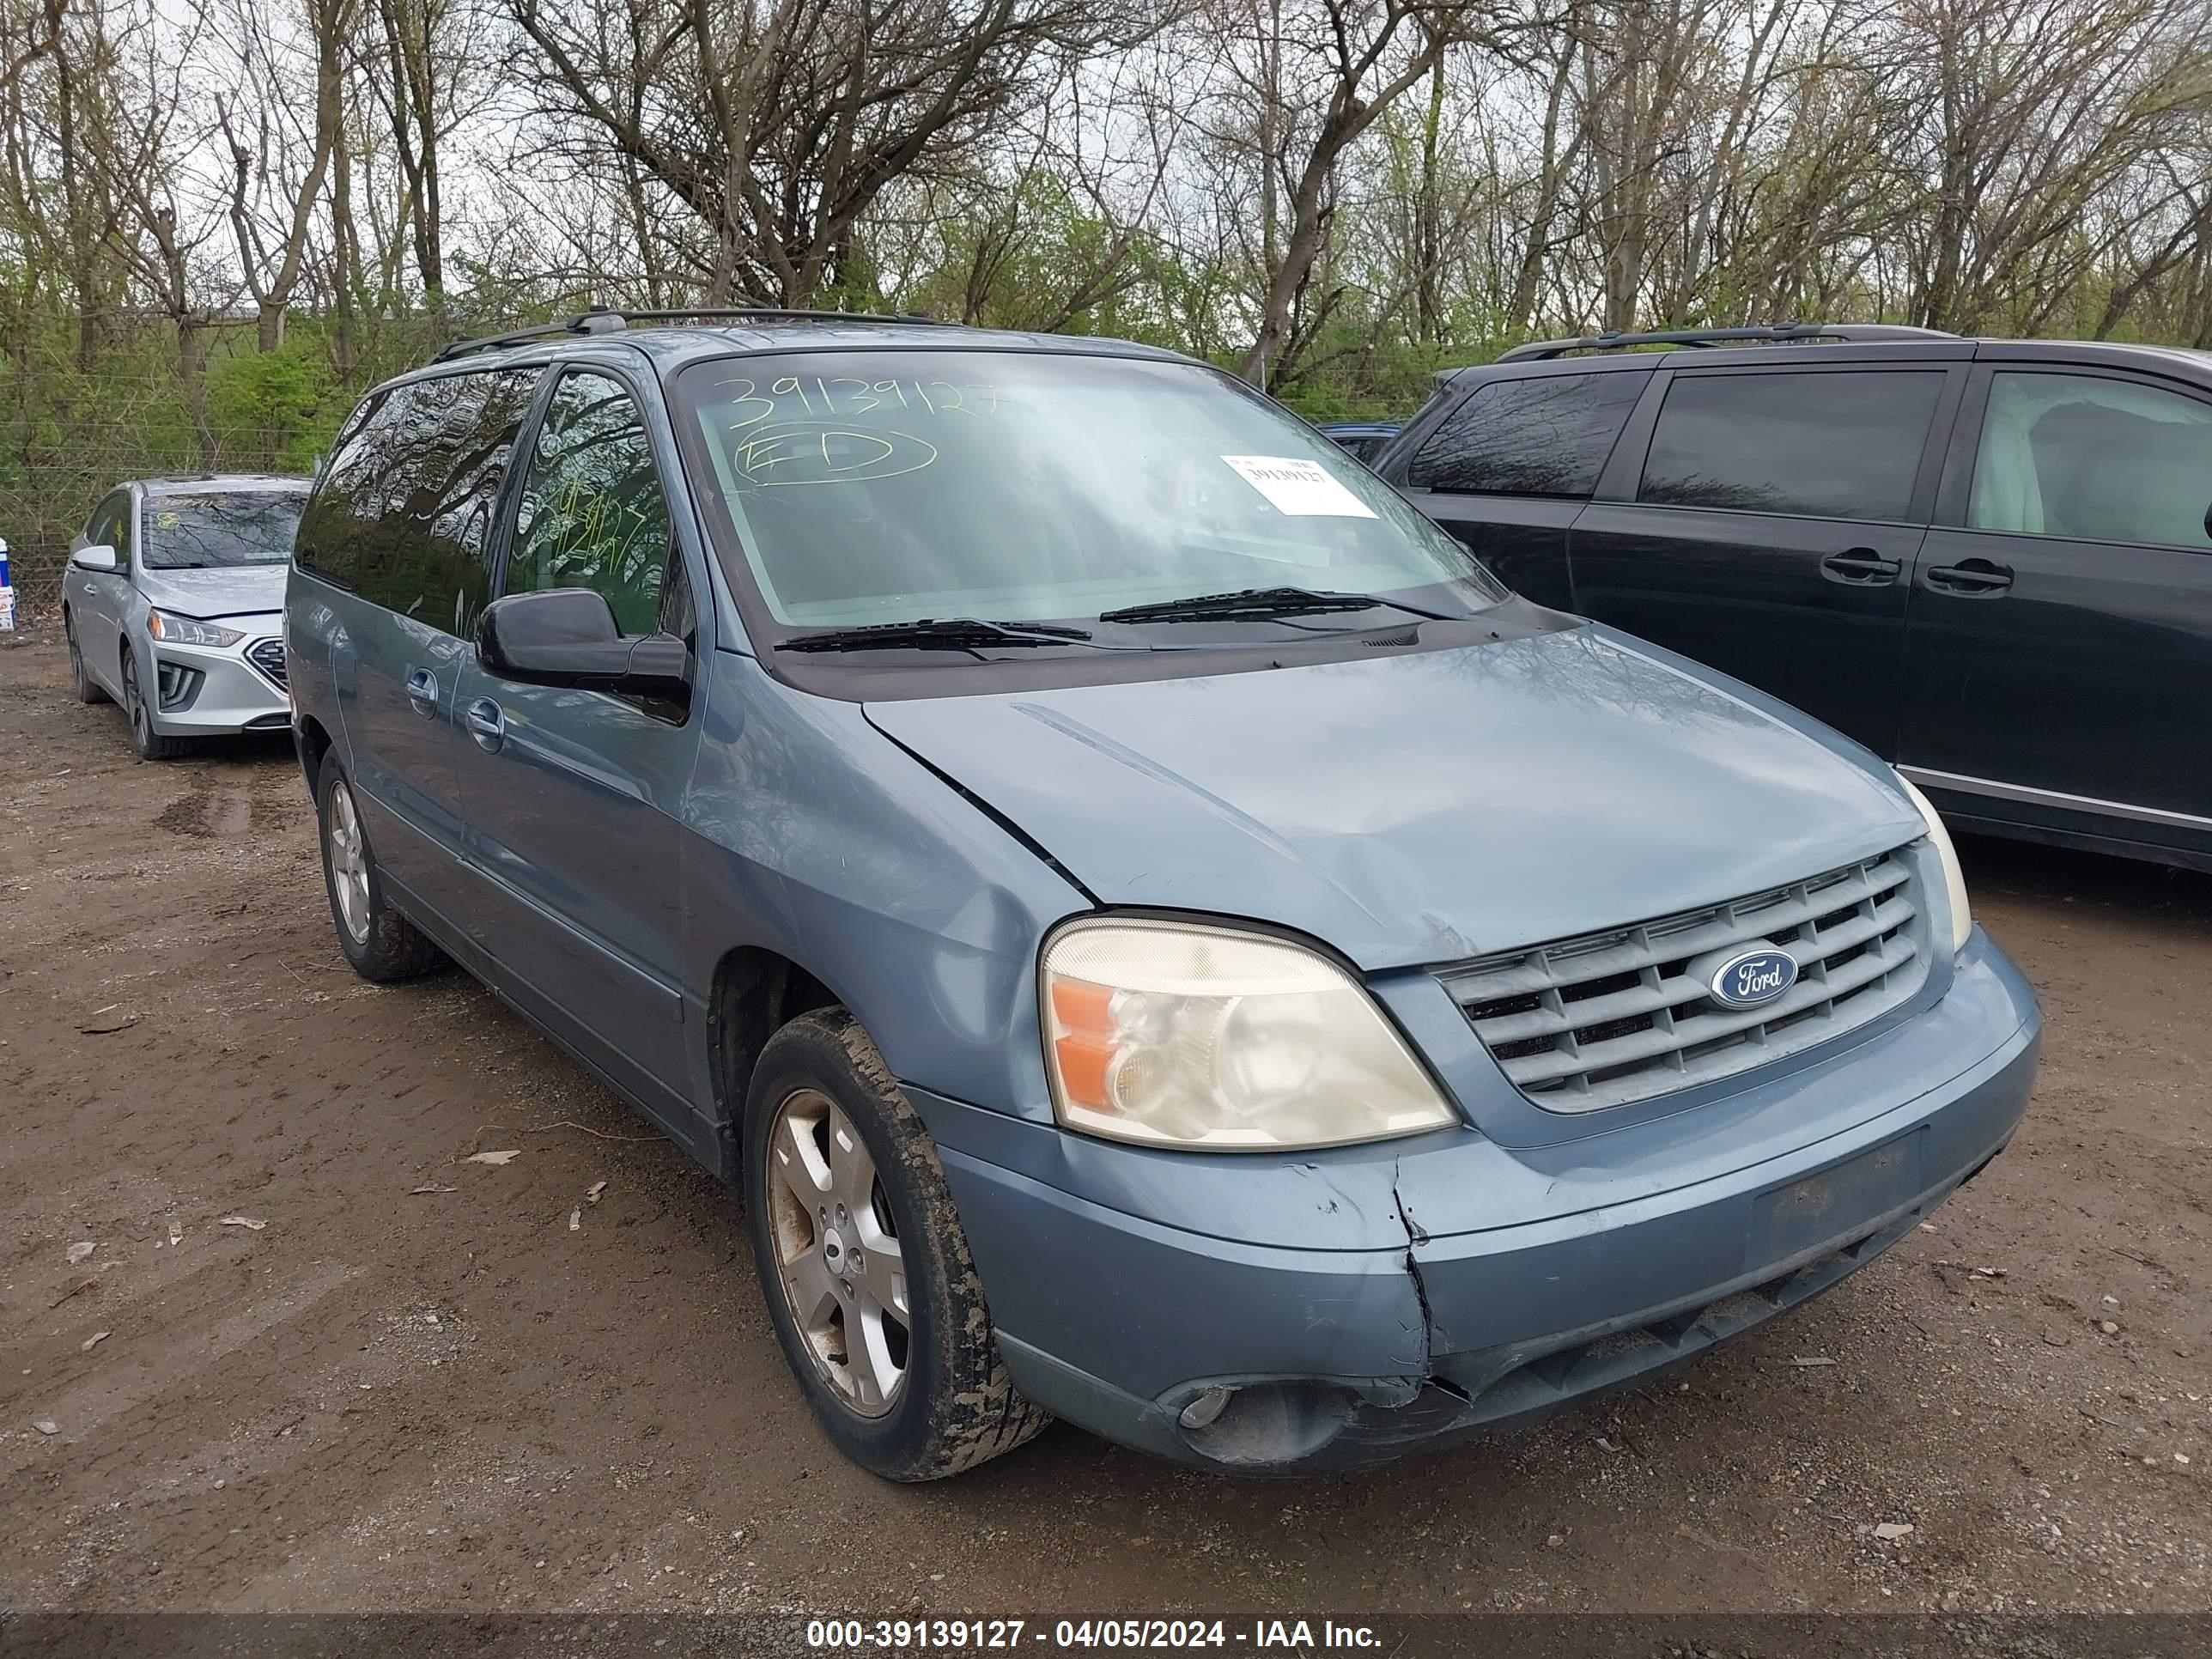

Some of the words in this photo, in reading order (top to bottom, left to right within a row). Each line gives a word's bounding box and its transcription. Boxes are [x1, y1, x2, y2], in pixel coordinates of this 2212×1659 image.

[714, 377, 1011, 429] 39139127
[1247, 470, 1325, 483] 39139127
[1738, 960, 1783, 996] Ford
